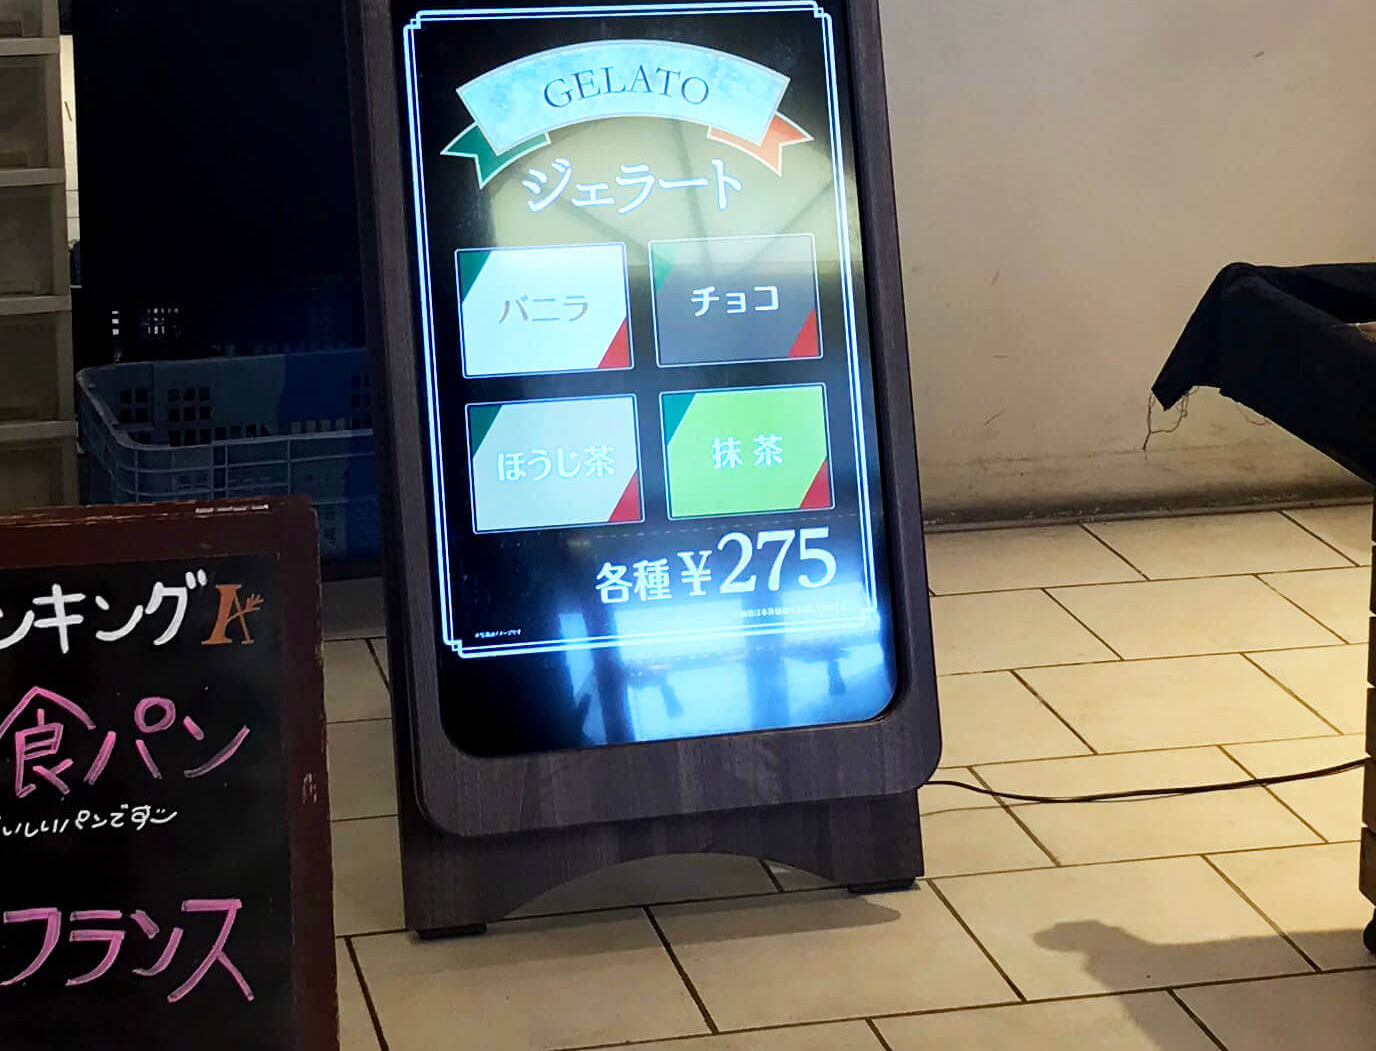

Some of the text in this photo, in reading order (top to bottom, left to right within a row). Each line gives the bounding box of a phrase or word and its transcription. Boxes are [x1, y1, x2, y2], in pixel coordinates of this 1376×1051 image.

[543, 64, 710, 110] GELATO
[521, 157, 743, 215] ジェラート
[497, 294, 590, 325] バニラ
[690, 285, 780, 318] チョコ
[497, 445, 617, 482] ほうじ茶
[710, 433, 785, 469] 抹茶
[0, 685, 252, 799] 食パン
[0, 898, 256, 1004] フランス
